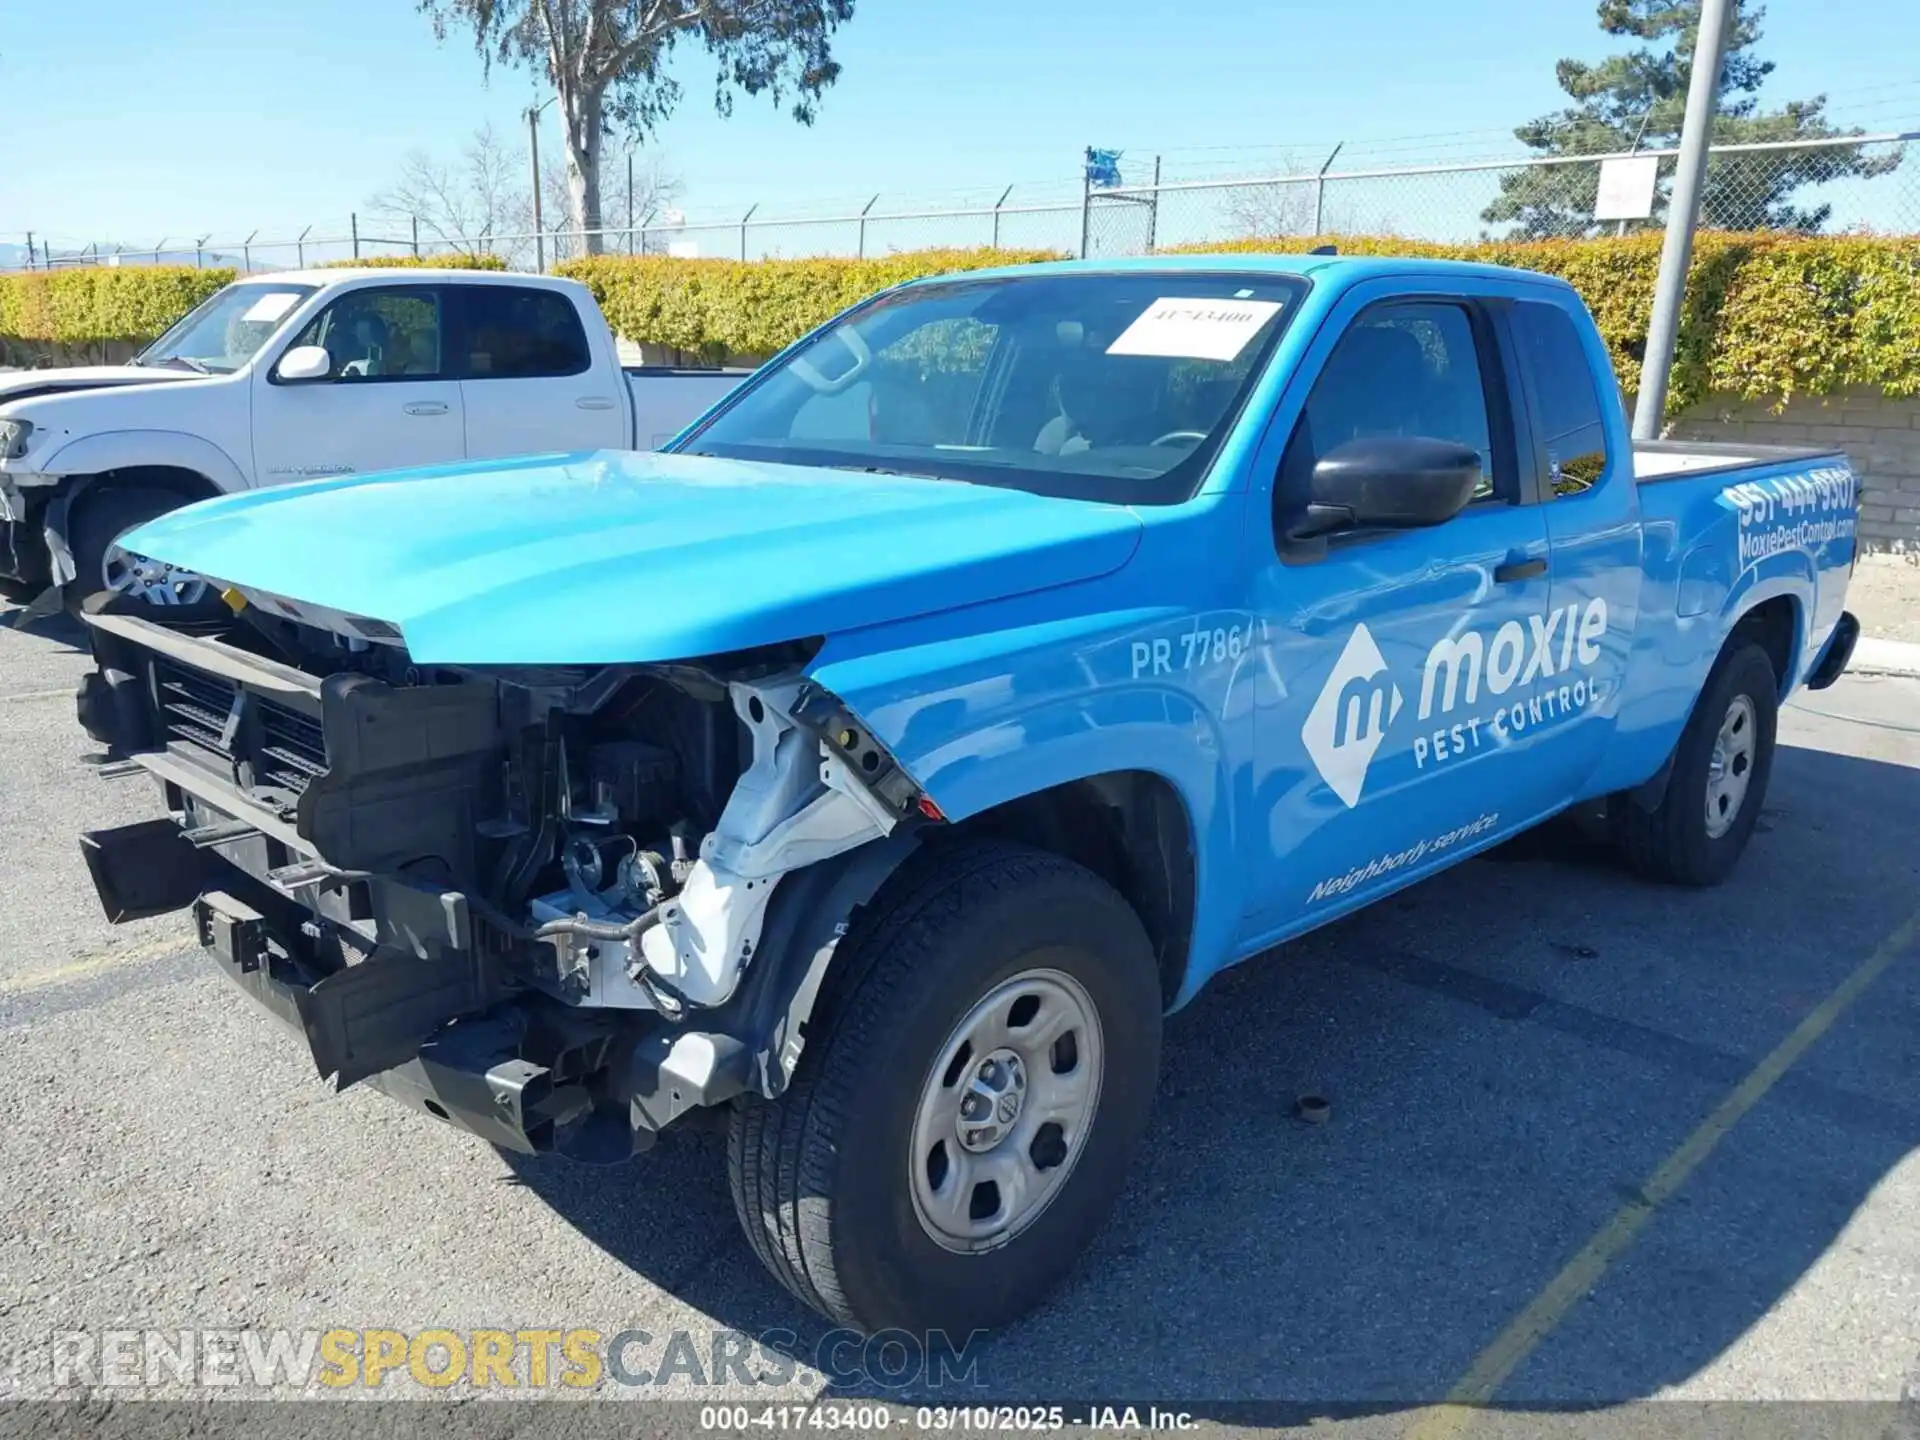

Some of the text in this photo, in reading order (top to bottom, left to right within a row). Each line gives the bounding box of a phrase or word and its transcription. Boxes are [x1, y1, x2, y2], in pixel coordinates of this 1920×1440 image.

[1131, 624, 1242, 679] PR 7786
[1413, 675, 1600, 769] PEST CONTROL
[1306, 810, 1500, 905] Neighborly service
